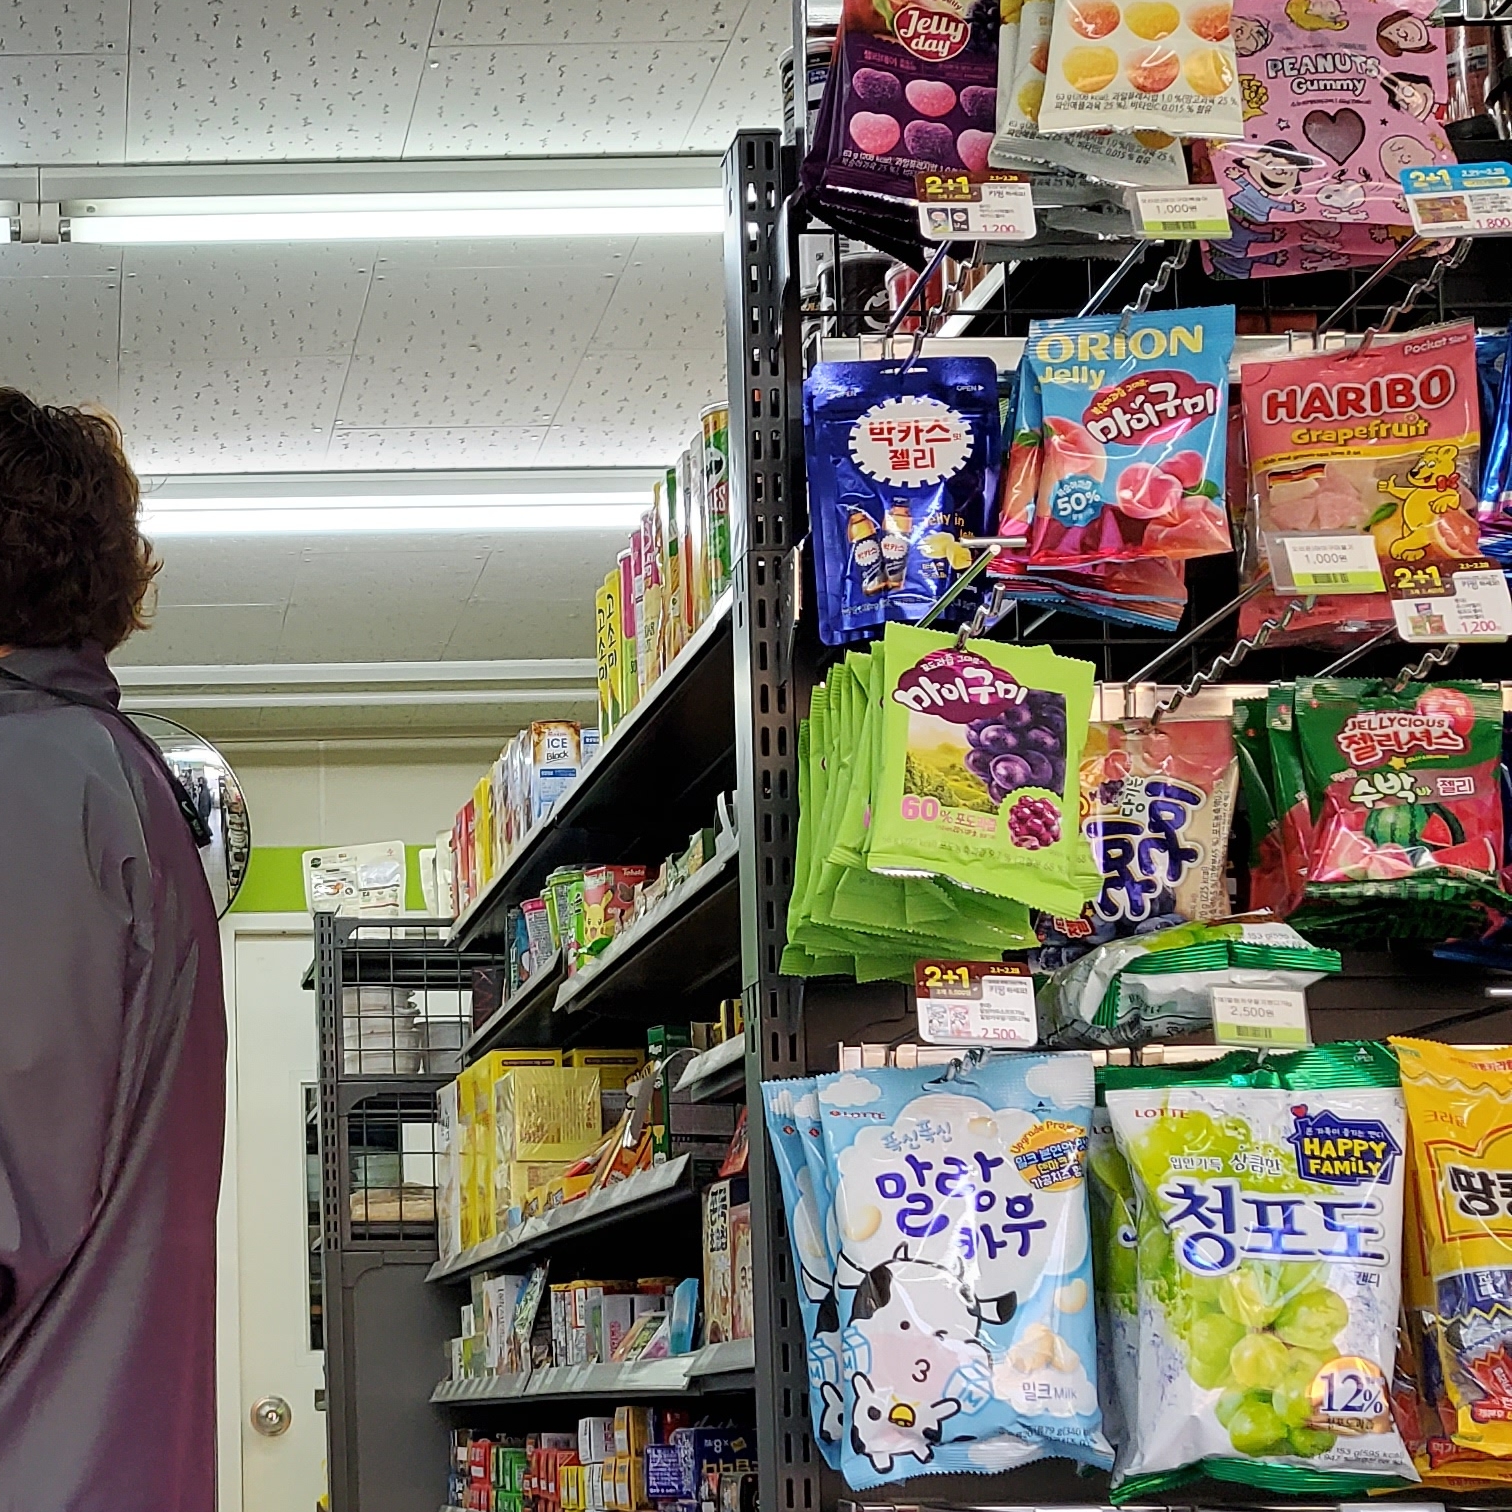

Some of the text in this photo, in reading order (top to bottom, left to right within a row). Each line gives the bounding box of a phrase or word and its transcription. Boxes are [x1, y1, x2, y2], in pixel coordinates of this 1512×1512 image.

[899, 9, 966, 43] Jelly
[910, 36, 951, 58] day
[1266, 53, 1381, 79] PEANUTS
[1291, 76, 1366, 97] Gummy
[1161, 103, 1185, 113] 0.015
[925, 175, 969, 195] 2+1
[1035, 324, 1203, 365] ORION
[1403, 338, 1447, 356] Pocket
[956, 383, 978, 393] OPEN
[1037, 365, 1106, 390] Jelly
[1264, 365, 1454, 423] HARIBO
[1086, 381, 1219, 444] 마이구미
[868, 419, 952, 447] 박카스
[1291, 415, 1430, 446] Grapefruit
[888, 447, 936, 471] 젤리
[1056, 490, 1101, 512] 50%
[1304, 553, 1348, 564] 1,000원
[1393, 565, 1442, 589] 2+1
[606, 593, 619, 668] 고소미
[597, 607, 609, 681] 고소미
[893, 665, 1029, 712] 마이구미
[1347, 716, 1446, 732] JELLYCIOUS
[546, 737, 569, 750] ICE
[1341, 728, 1465, 763] 젤리셔스
[546, 749, 570, 763] Black
[1439, 777, 1473, 794] 젤리
[924, 965, 970, 989] 2+1
[1230, 1006, 1275, 1018] 2,500원
[842, 1109, 886, 1119] LOTTE
[1134, 1107, 1190, 1119] LOTTE
[1010, 1123, 1045, 1154] Upgrade
[1303, 1137, 1386, 1159] HAPPY
[1015, 1153, 1039, 1170] 밀크
[1169, 1153, 1281, 1175] 입안가득 상큼한
[1031, 1167, 1072, 1189] 가공치즈
[875, 1151, 1004, 1237] 말랑
[949, 1194, 1047, 1260] 카우
[1164, 1182, 1386, 1272] 청포도
[1355, 1271, 1380, 1287] 캔디
[1022, 1381, 1078, 1400] 밀크 Milk
[1320, 1372, 1383, 1414] 12%
